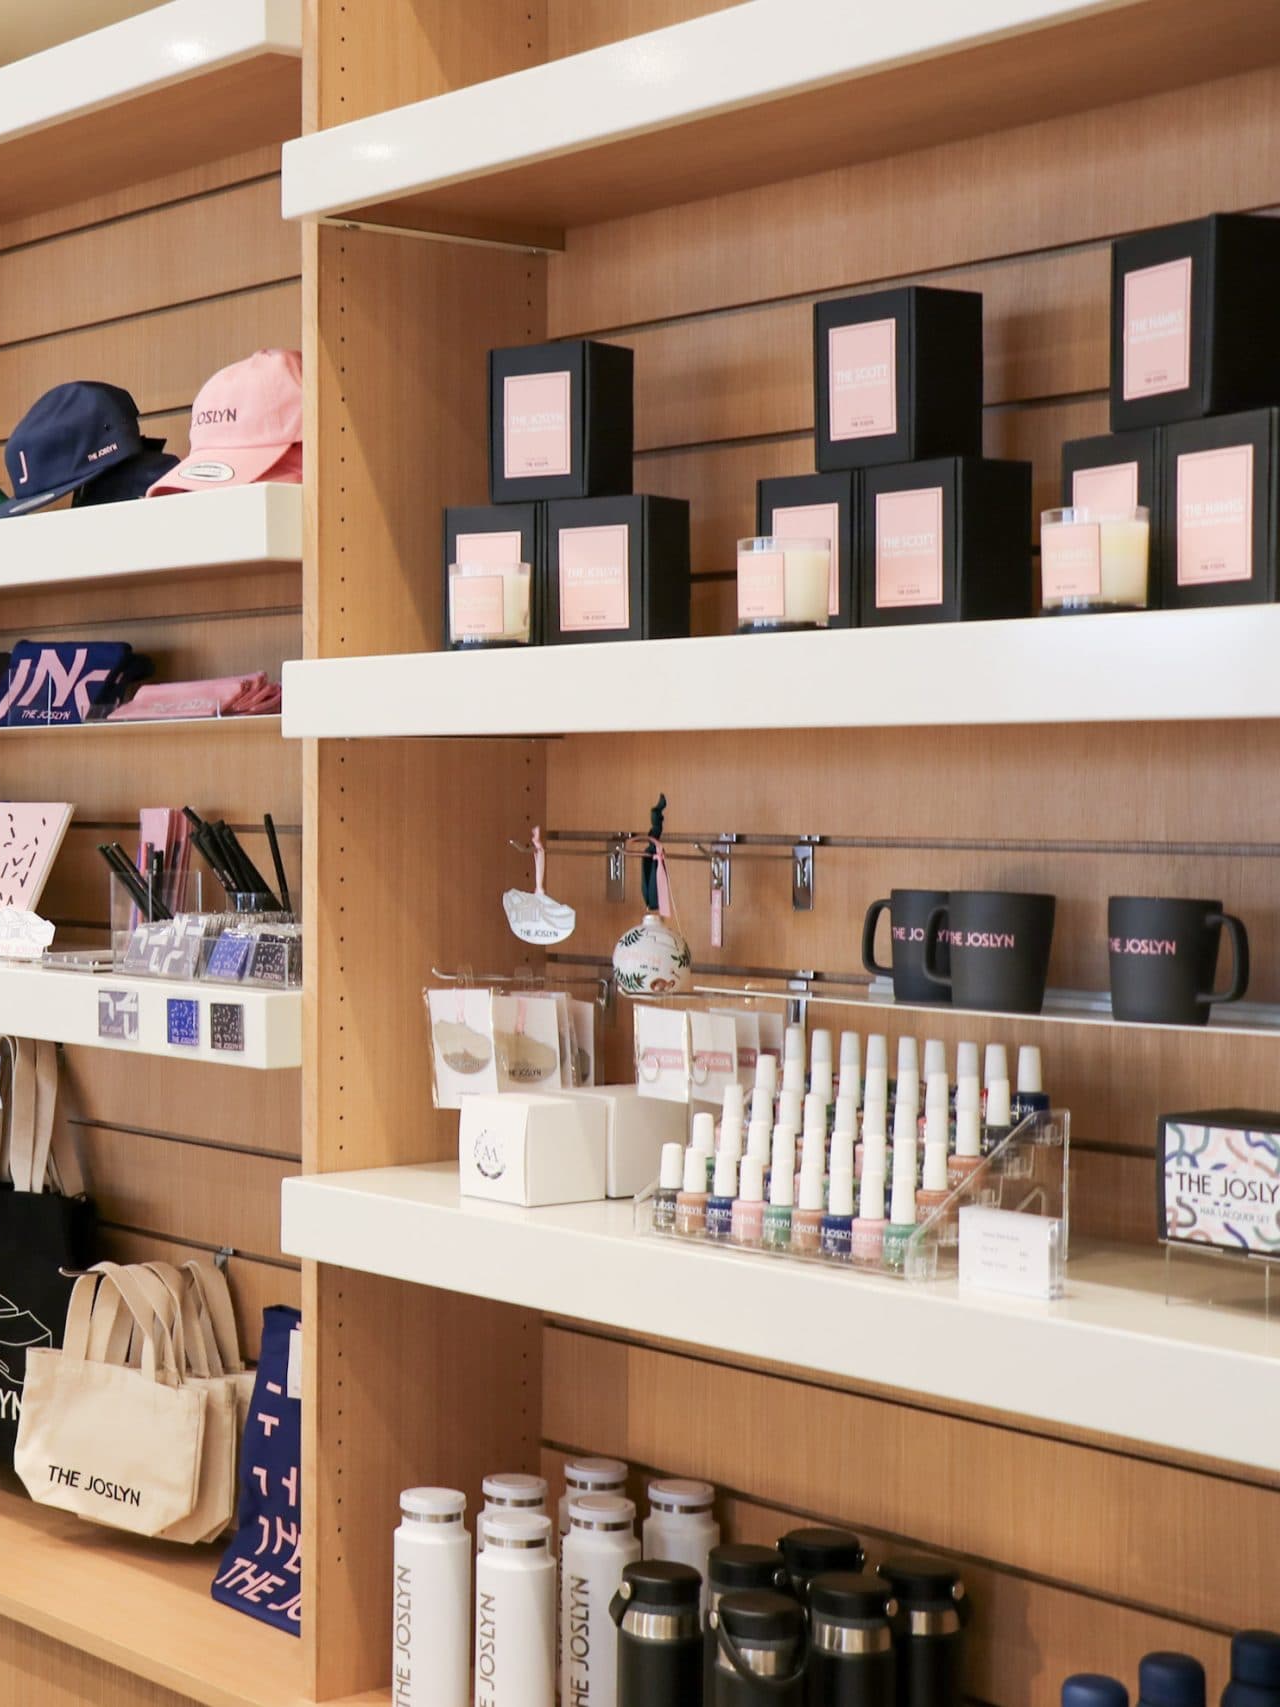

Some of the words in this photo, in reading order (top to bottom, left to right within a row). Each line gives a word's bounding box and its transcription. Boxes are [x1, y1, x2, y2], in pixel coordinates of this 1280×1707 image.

[194, 408, 237, 427] OSLYN
[19, 450, 29, 485] J
[21, 709, 36, 720] THE
[37, 710, 71, 721] JOSLYN
[534, 929, 559, 938] JOSLYN
[966, 932, 1015, 948] JOSLYN
[1109, 938, 1121, 952] HE
[1123, 938, 1177, 954] JOSLYN
[1176, 1171, 1213, 1196] THE
[1219, 1177, 1280, 1206] JOSLY
[48, 1464, 82, 1488] THE
[84, 1475, 141, 1507] JOSLYN
[215, 1556, 287, 1603] THE
[396, 1565, 412, 1660] JOSLYN
[570, 1575, 590, 1672] JOSLYN
[479, 1592, 496, 1691] JOSLYN
[570, 1677, 590, 1707] HE
